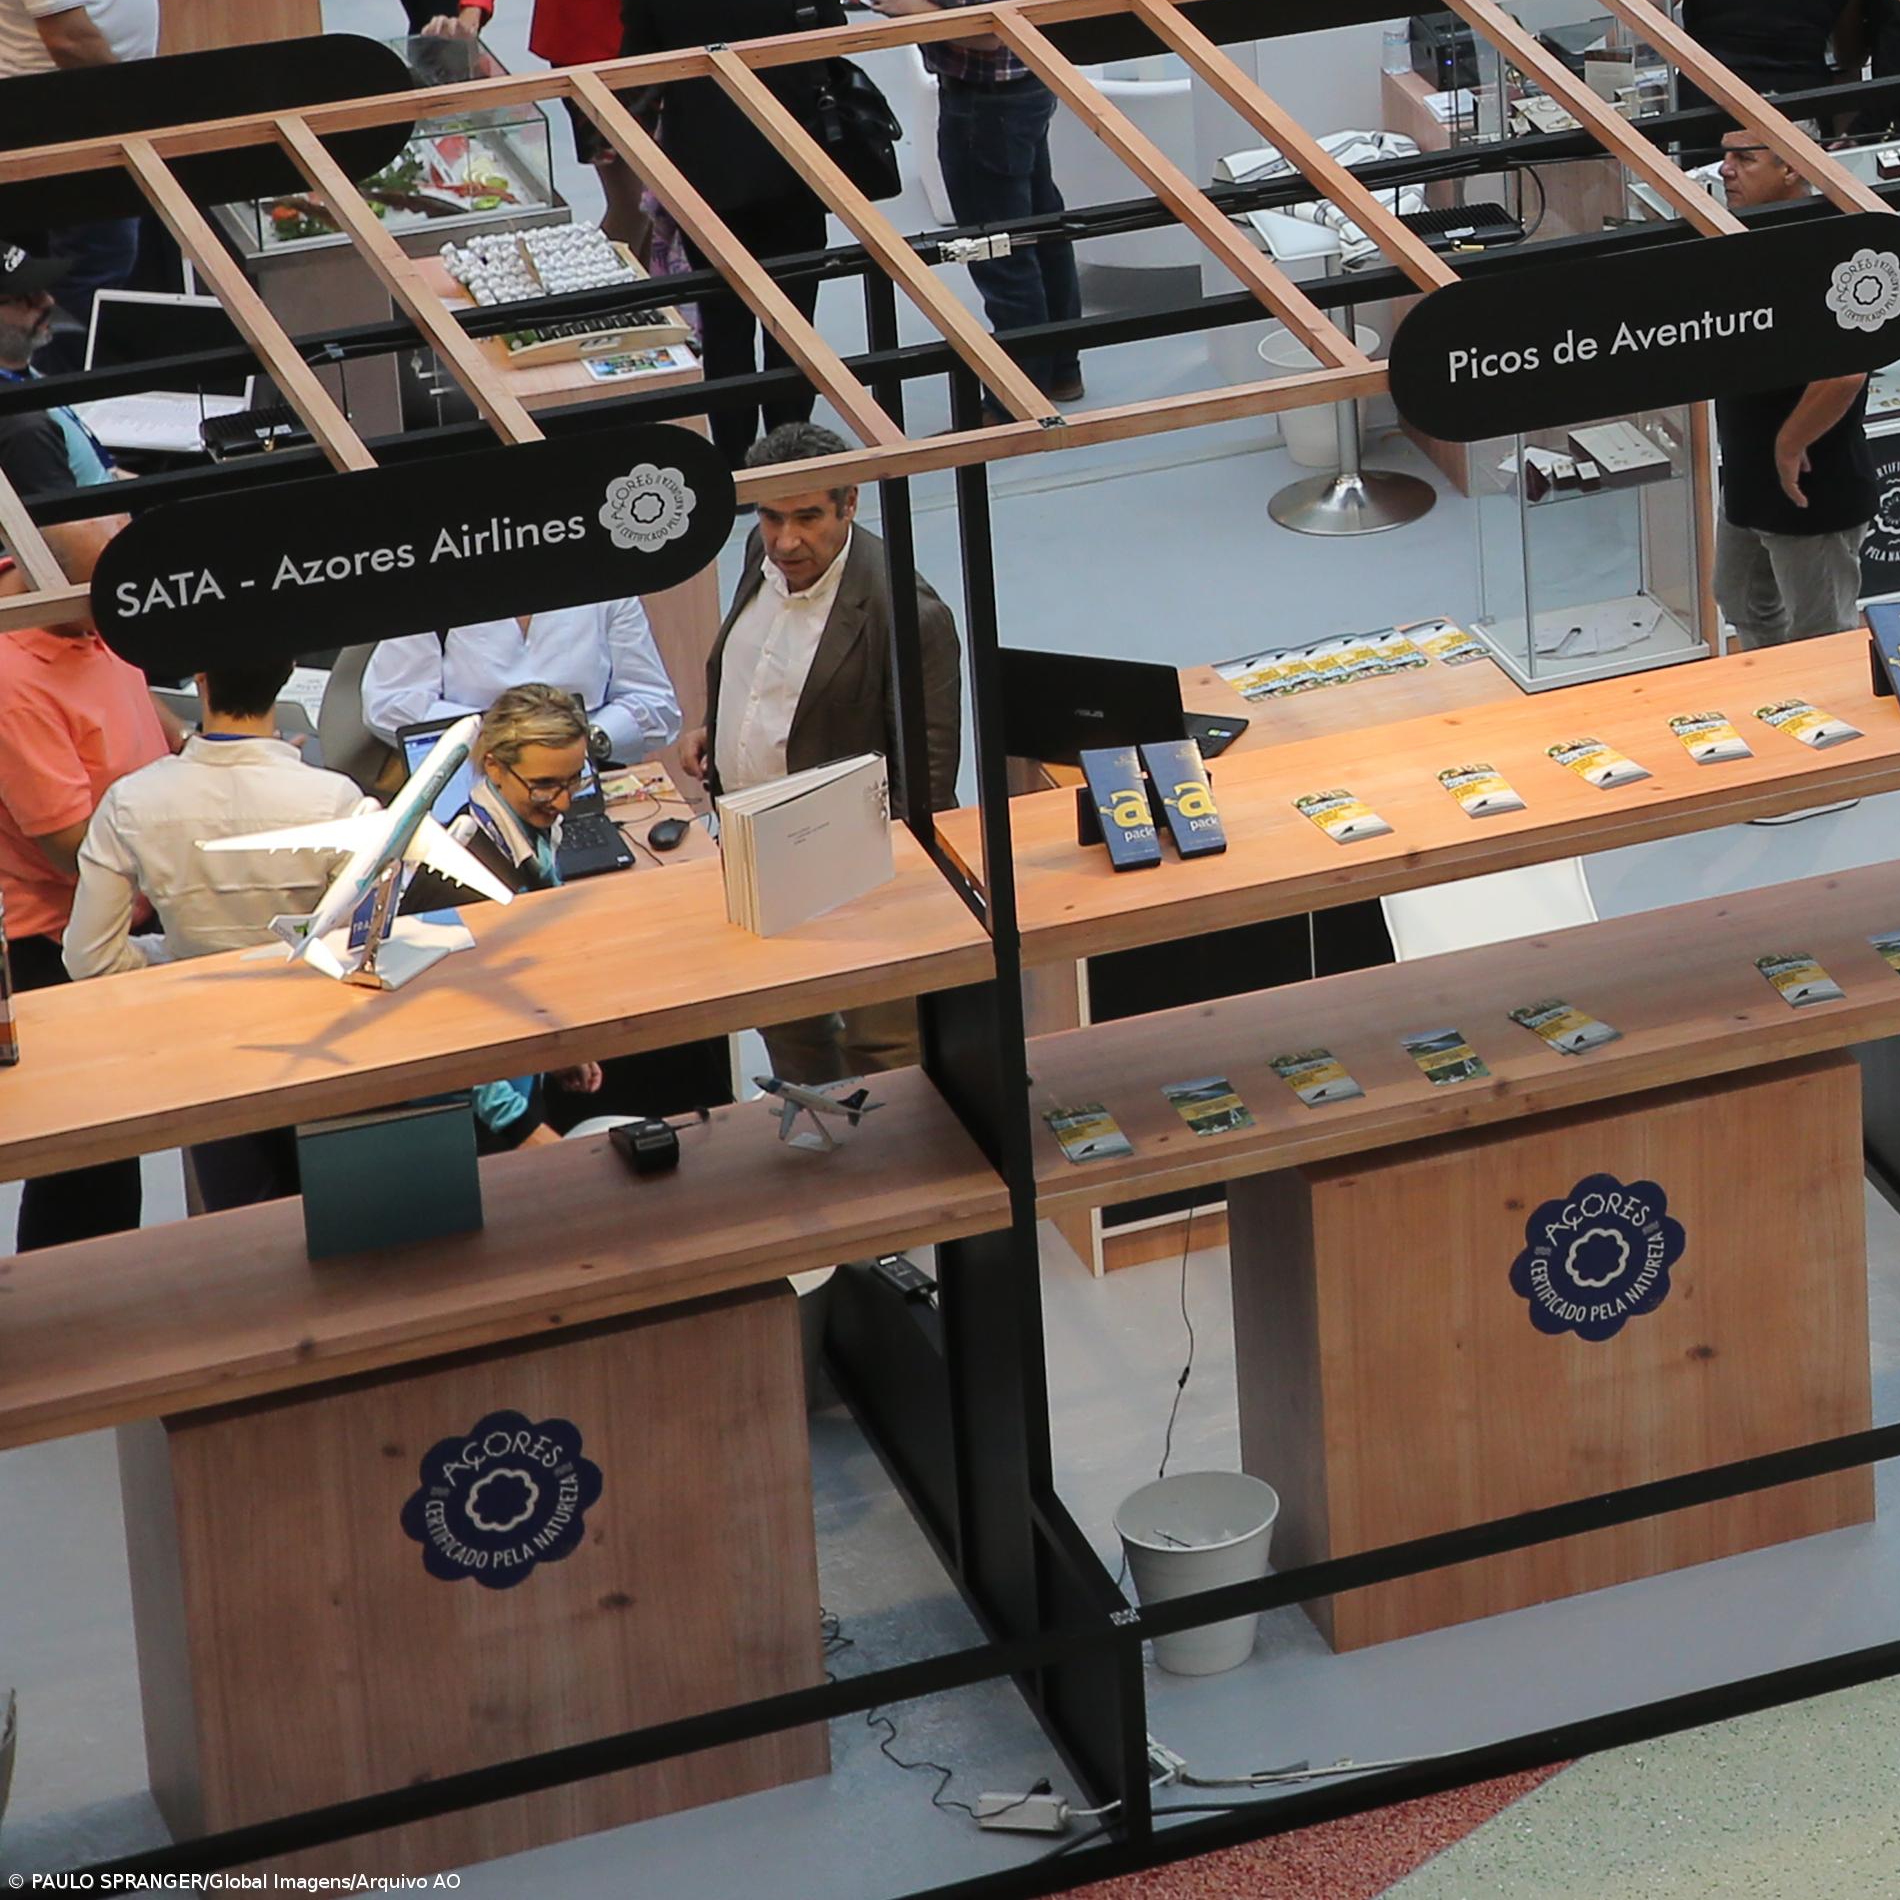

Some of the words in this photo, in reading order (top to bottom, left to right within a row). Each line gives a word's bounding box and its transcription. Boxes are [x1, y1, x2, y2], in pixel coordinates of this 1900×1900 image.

[1448, 347, 1540, 382] Picos
[1552, 330, 1599, 366] de
[1609, 306, 1775, 357] Aventura
[611, 473, 653, 521] AÇORES
[115, 567, 227, 618] SATA
[272, 542, 416, 591] Azores
[429, 508, 587, 564] Airlines
[1864, 544, 1887, 562] PELA
[1544, 1191, 1650, 1247] AÇORES
[1530, 1258, 1586, 1323] CERTIFICADO
[1591, 1298, 1624, 1322] PELA
[1624, 1230, 1665, 1306] NATUREZA
[442, 1430, 563, 1487] AÇORES
[424, 1499, 489, 1570] CERTIFICADO
[493, 1543, 536, 1570] PELA
[532, 1473, 579, 1552] NATUREZA
